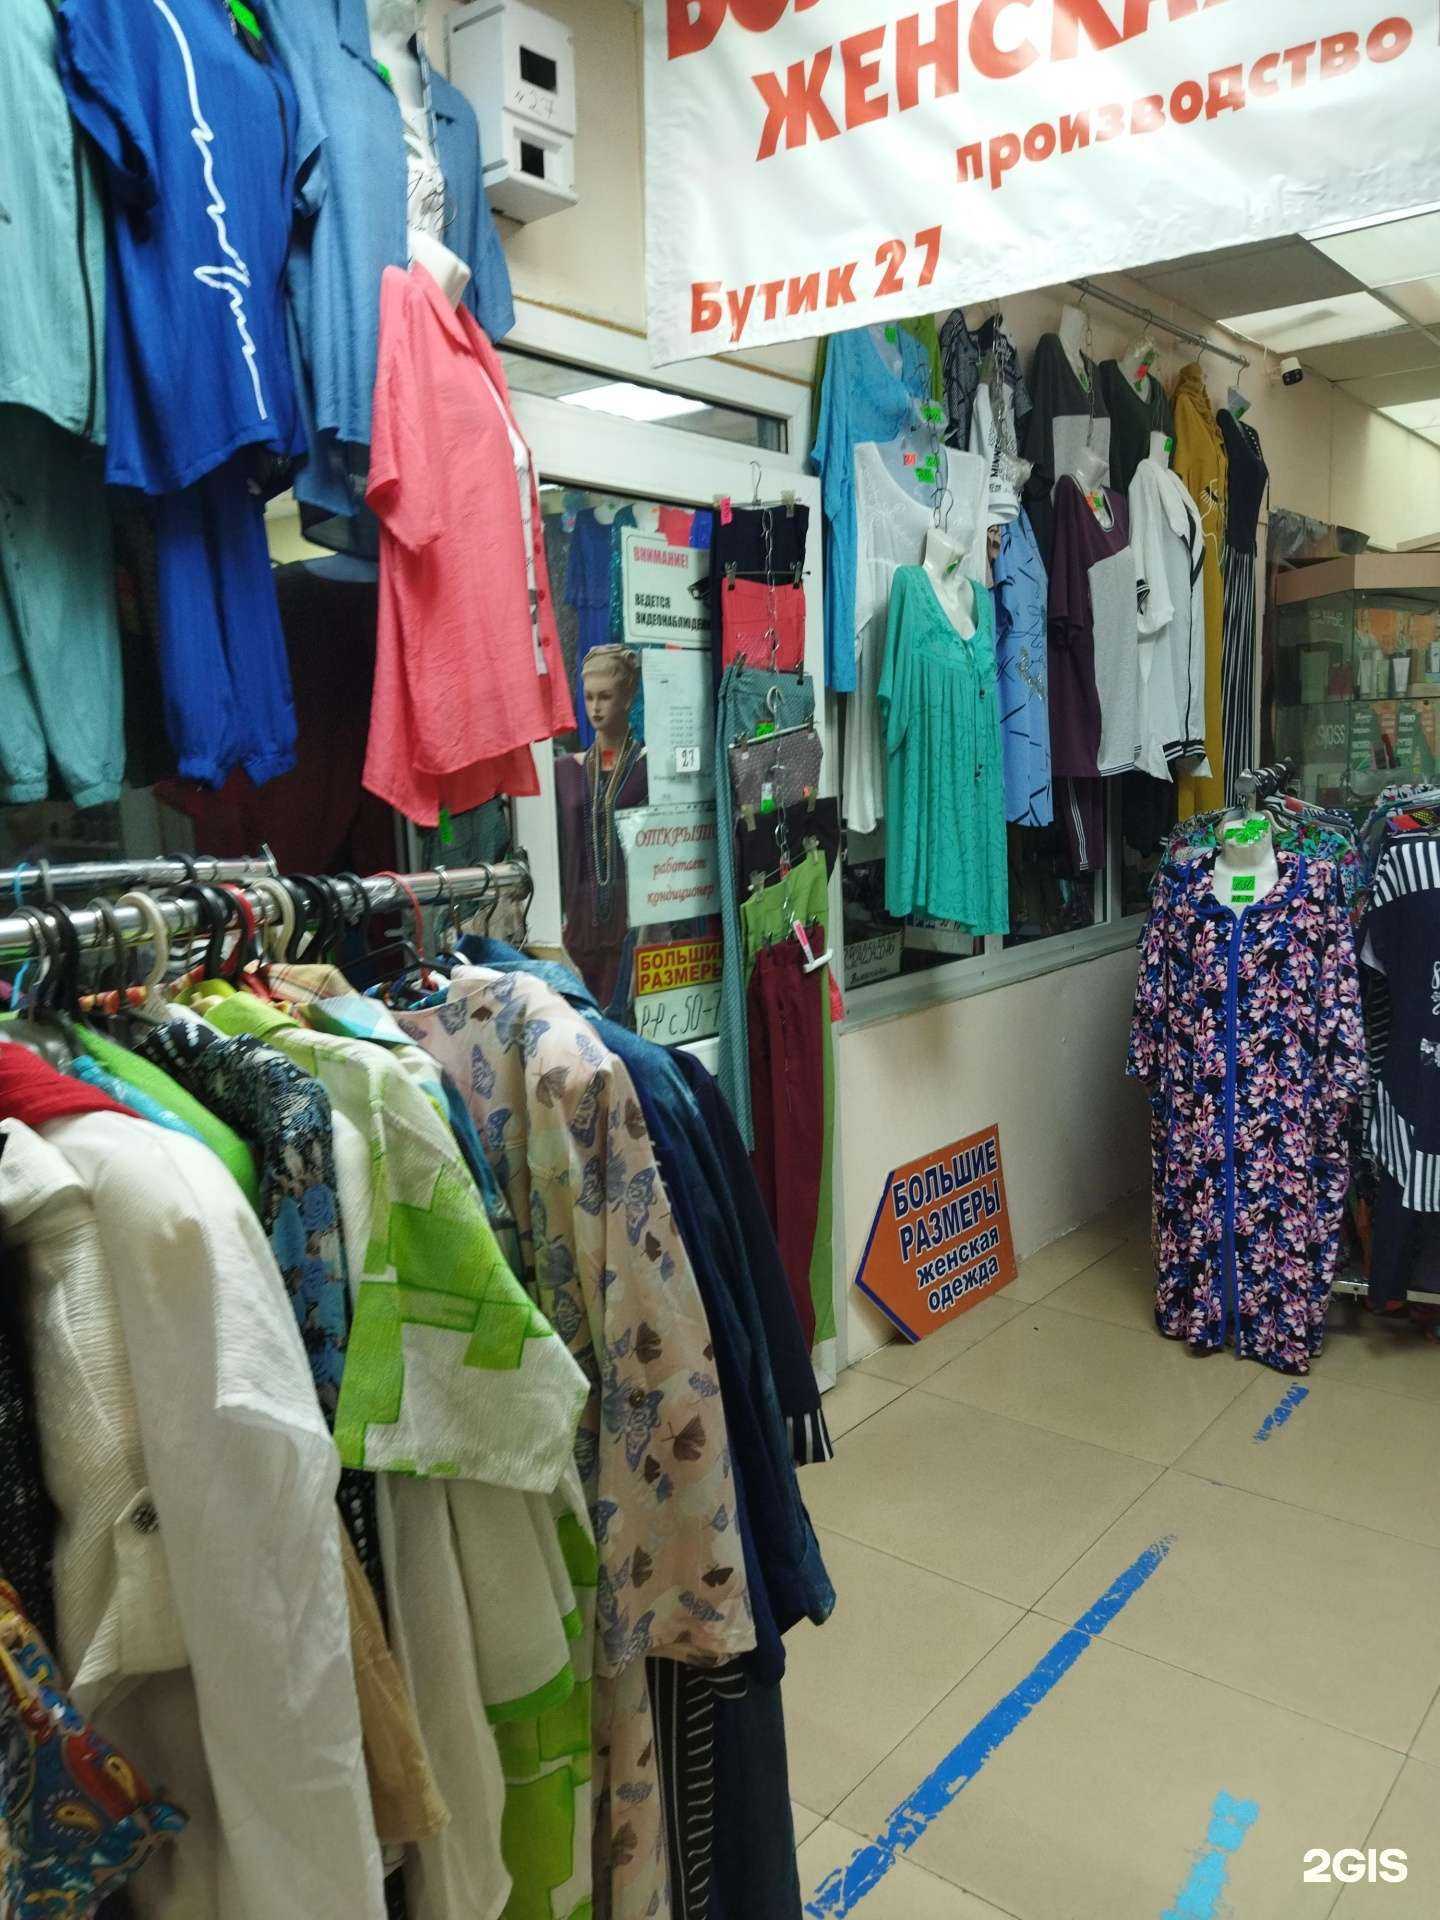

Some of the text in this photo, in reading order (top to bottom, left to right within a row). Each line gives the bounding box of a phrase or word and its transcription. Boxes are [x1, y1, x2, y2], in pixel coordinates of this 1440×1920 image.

[955, 16, 1413, 190] производство
[690, 225, 943, 343] Бутик 27
[633, 546, 689, 569] ВНИМАНИЕ!
[635, 593, 671, 609] ВЕДЕТСЯ
[681, 749, 695, 768] 27
[635, 823, 715, 848] ОТКРЫТ
[652, 857, 707, 880] работает
[640, 944, 722, 971] БОЛЬШИ
[682, 989, 721, 1033] 50-7
[892, 1137, 998, 1221] БОЛЬШИЕ
[899, 1178, 1001, 1264] РАЗМЕРЫ
[917, 1225, 999, 1291] женская
[928, 1255, 999, 1312] одежда
